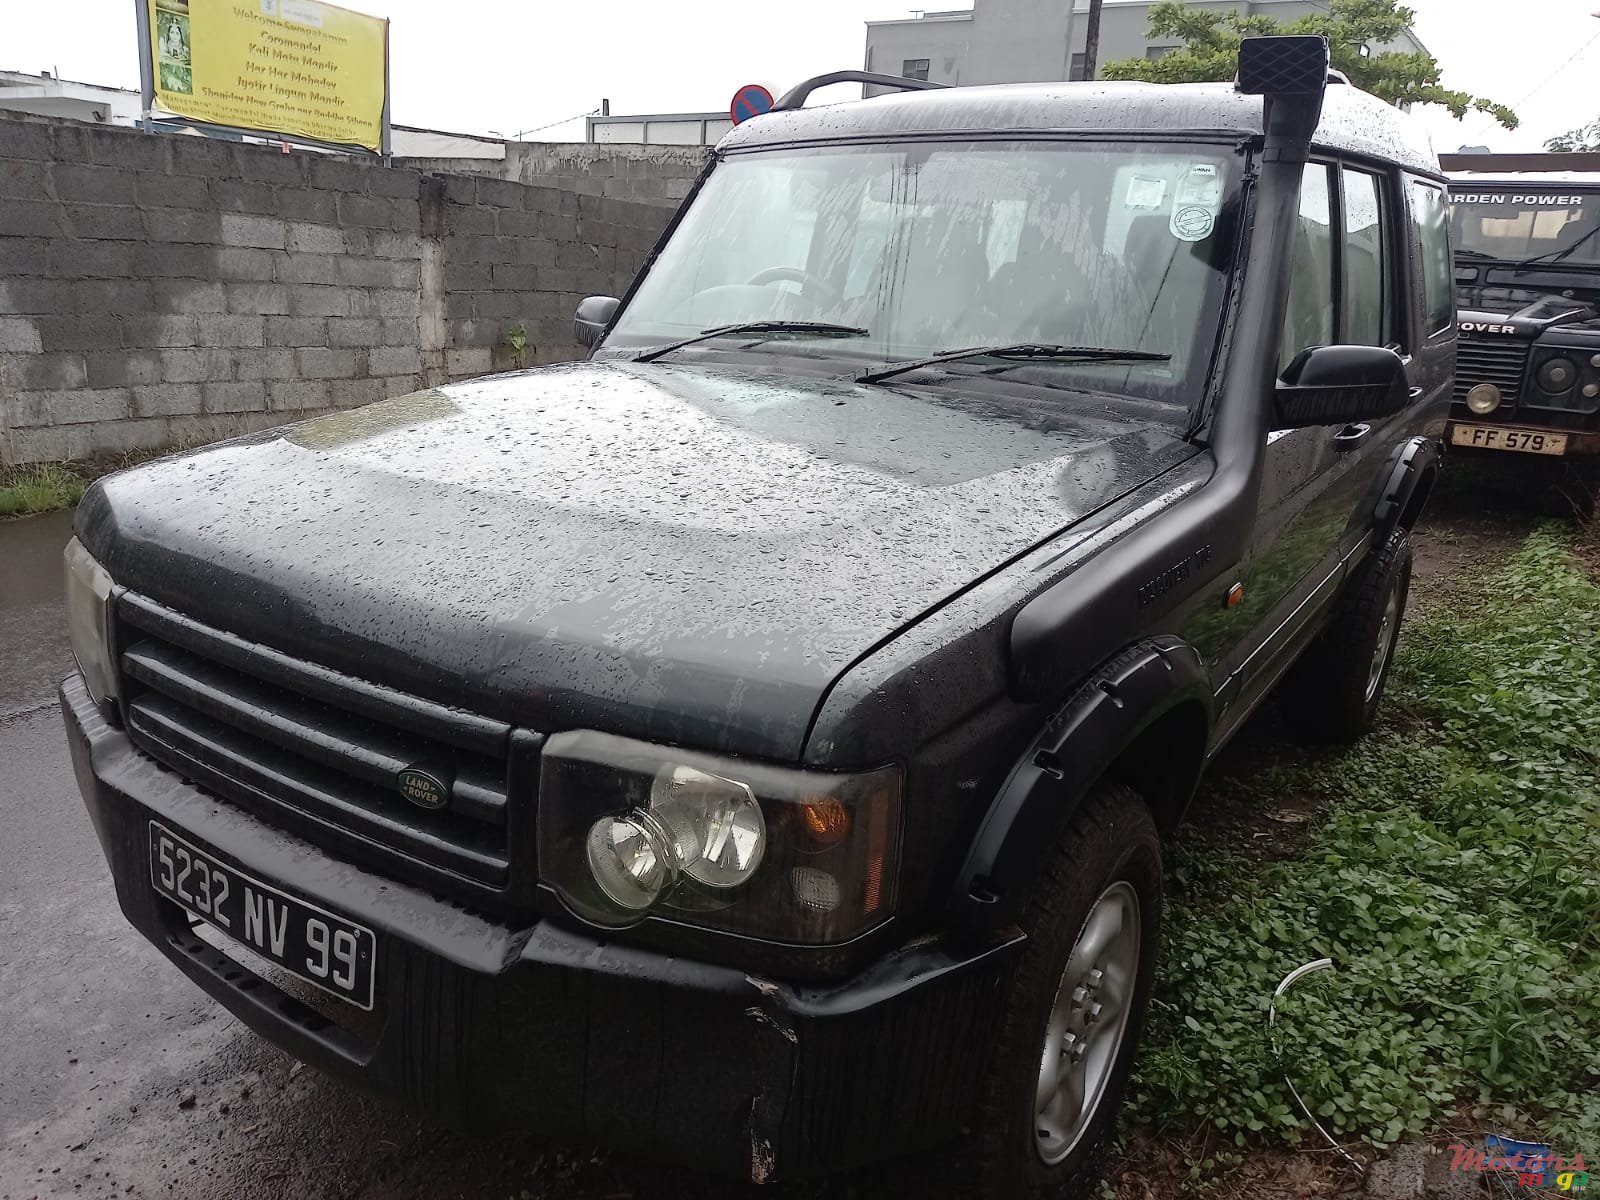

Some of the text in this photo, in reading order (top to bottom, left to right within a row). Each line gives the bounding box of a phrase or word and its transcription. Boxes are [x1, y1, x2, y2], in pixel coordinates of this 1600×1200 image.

[261, 31, 321, 53] Coromandel
[246, 61, 267, 74] Har
[269, 64, 288, 78] Har
[302, 54, 339, 72] Mandir
[310, 89, 345, 106] Mandir
[1512, 195, 1583, 205] POWER
[1457, 322, 1515, 335] OVER
[1472, 429, 1544, 451] FF 579
[158, 835, 357, 991] 5232 NV 99
